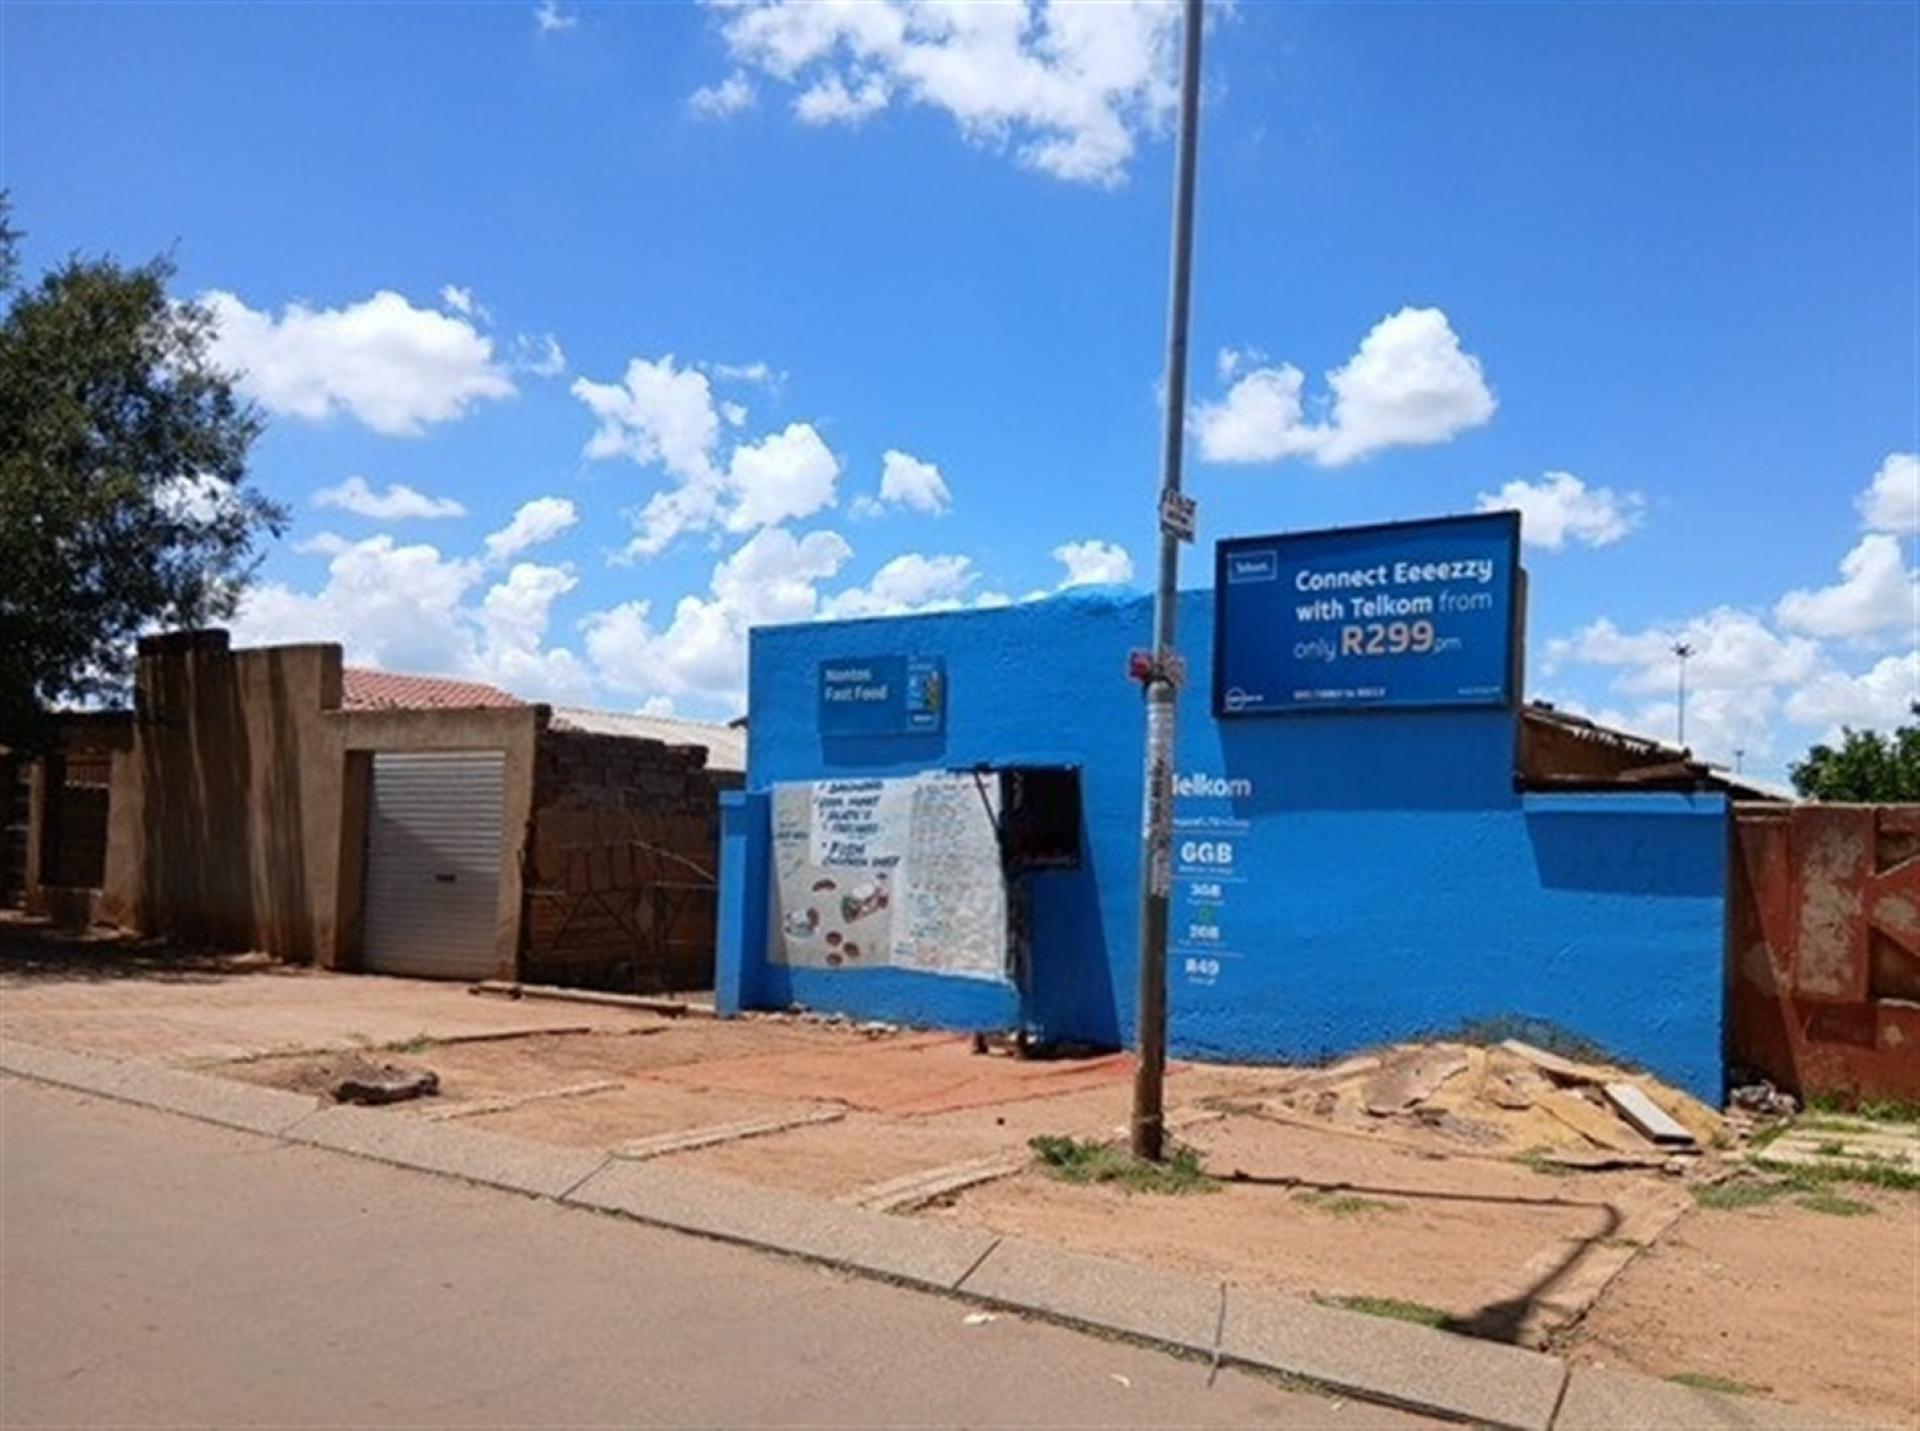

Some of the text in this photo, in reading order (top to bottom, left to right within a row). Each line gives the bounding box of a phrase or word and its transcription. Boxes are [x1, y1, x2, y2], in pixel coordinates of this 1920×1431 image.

[1295, 559, 1493, 592] Connect Eeeezzy
[1296, 589, 1493, 622] with Telkom from
[1293, 640, 1337, 662] only
[1341, 620, 1434, 656] R299
[825, 684, 888, 701] Fast Food
